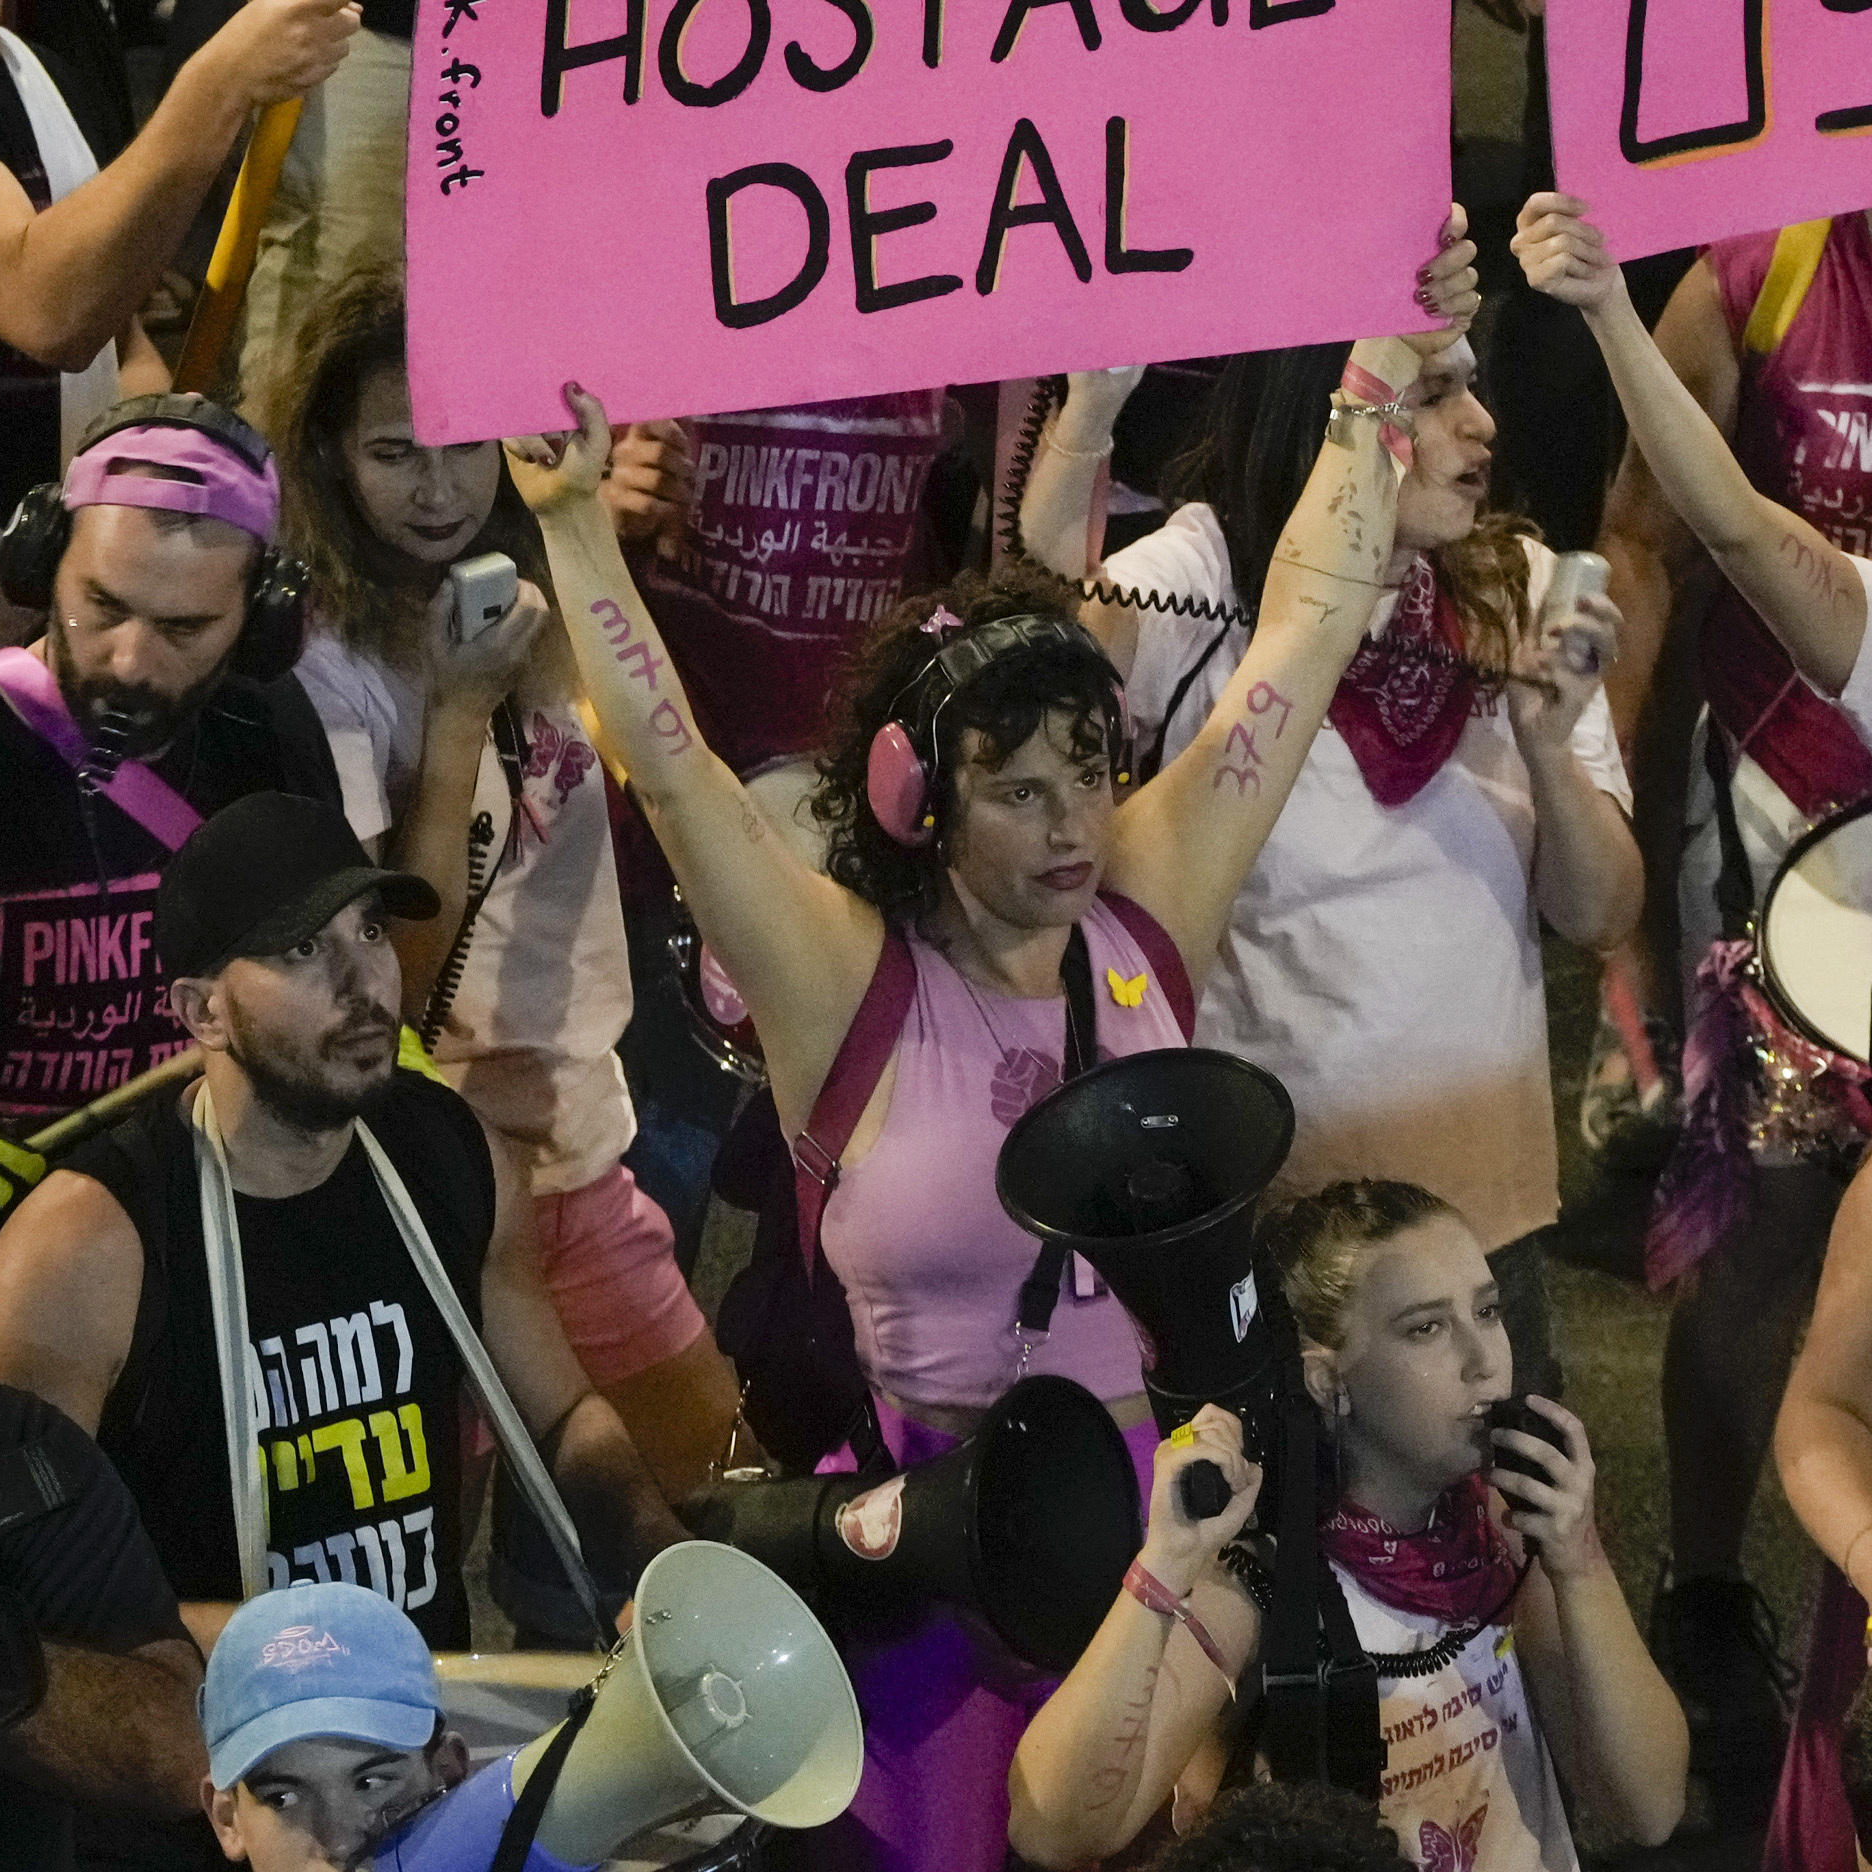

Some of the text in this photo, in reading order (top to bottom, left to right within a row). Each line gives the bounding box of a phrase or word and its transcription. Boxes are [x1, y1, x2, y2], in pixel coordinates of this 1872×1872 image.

[704, 113, 1196, 330] DEAL
[23, 910, 163, 987] PINKF
[295, 1298, 414, 1418] למה
